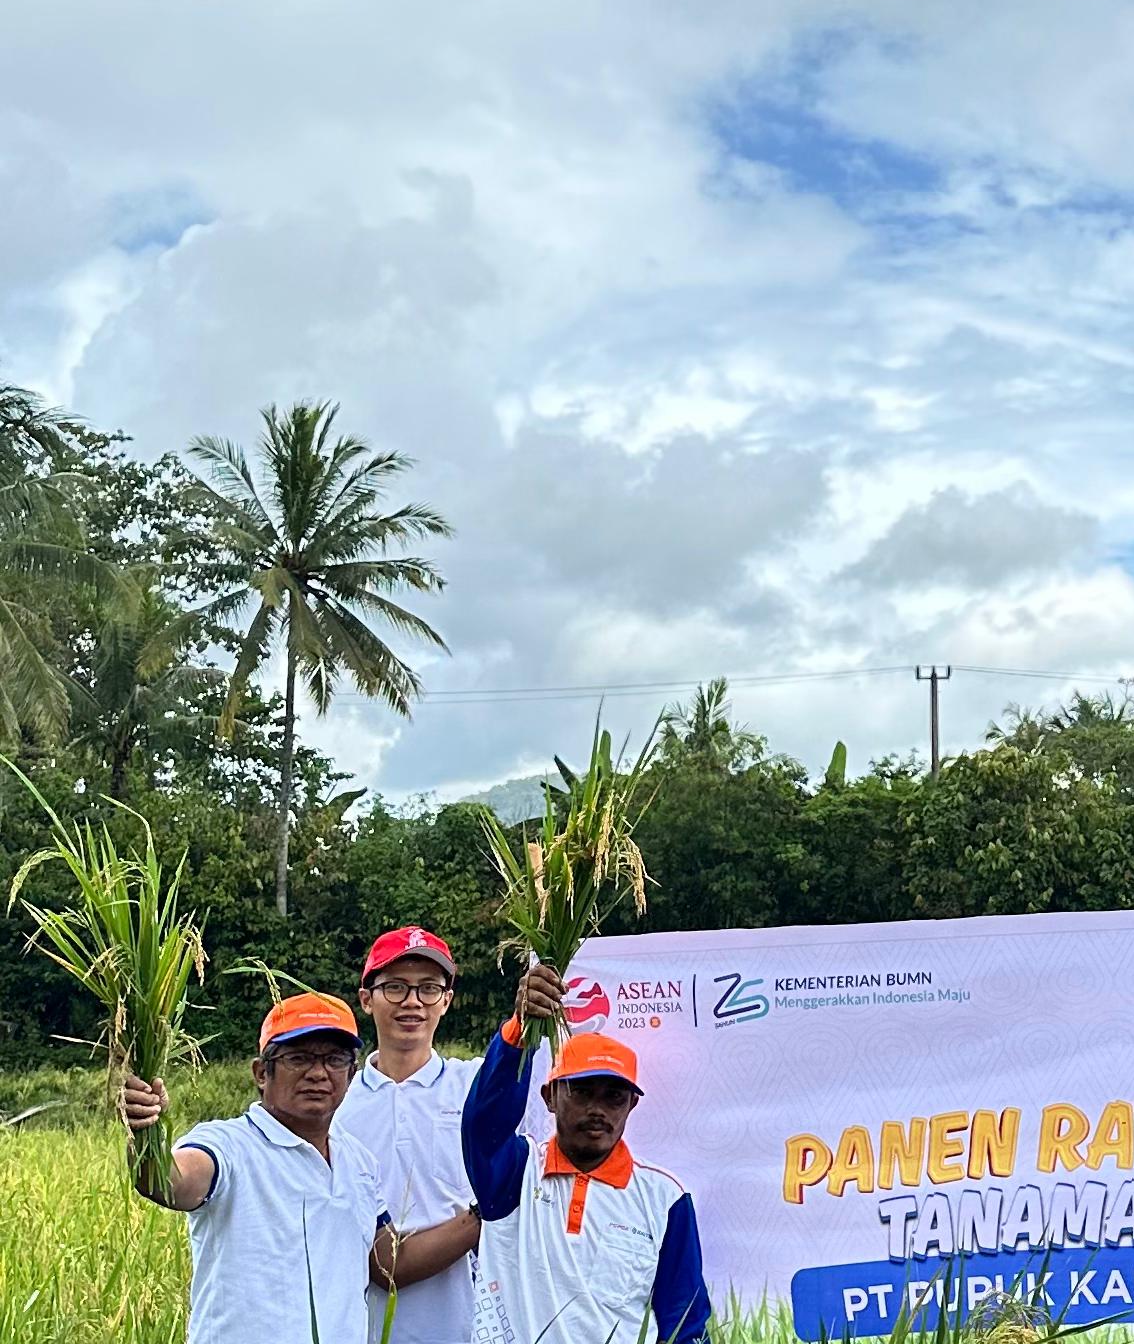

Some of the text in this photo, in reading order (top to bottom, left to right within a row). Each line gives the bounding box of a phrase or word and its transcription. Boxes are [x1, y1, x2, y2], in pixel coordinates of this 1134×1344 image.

[617, 980, 682, 1001] ASEAN
[774, 971, 932, 992] KEMENTERIAN BUMN
[617, 1002, 683, 1015] INDONESIA
[774, 988, 971, 1010] Menggerakkan Indonesia Maju
[617, 1017, 646, 1029] 2023
[783, 1107, 1021, 1204] PANEN
[842, 1283, 893, 1322] PT
[908, 1271, 1056, 1312] PUPUK
